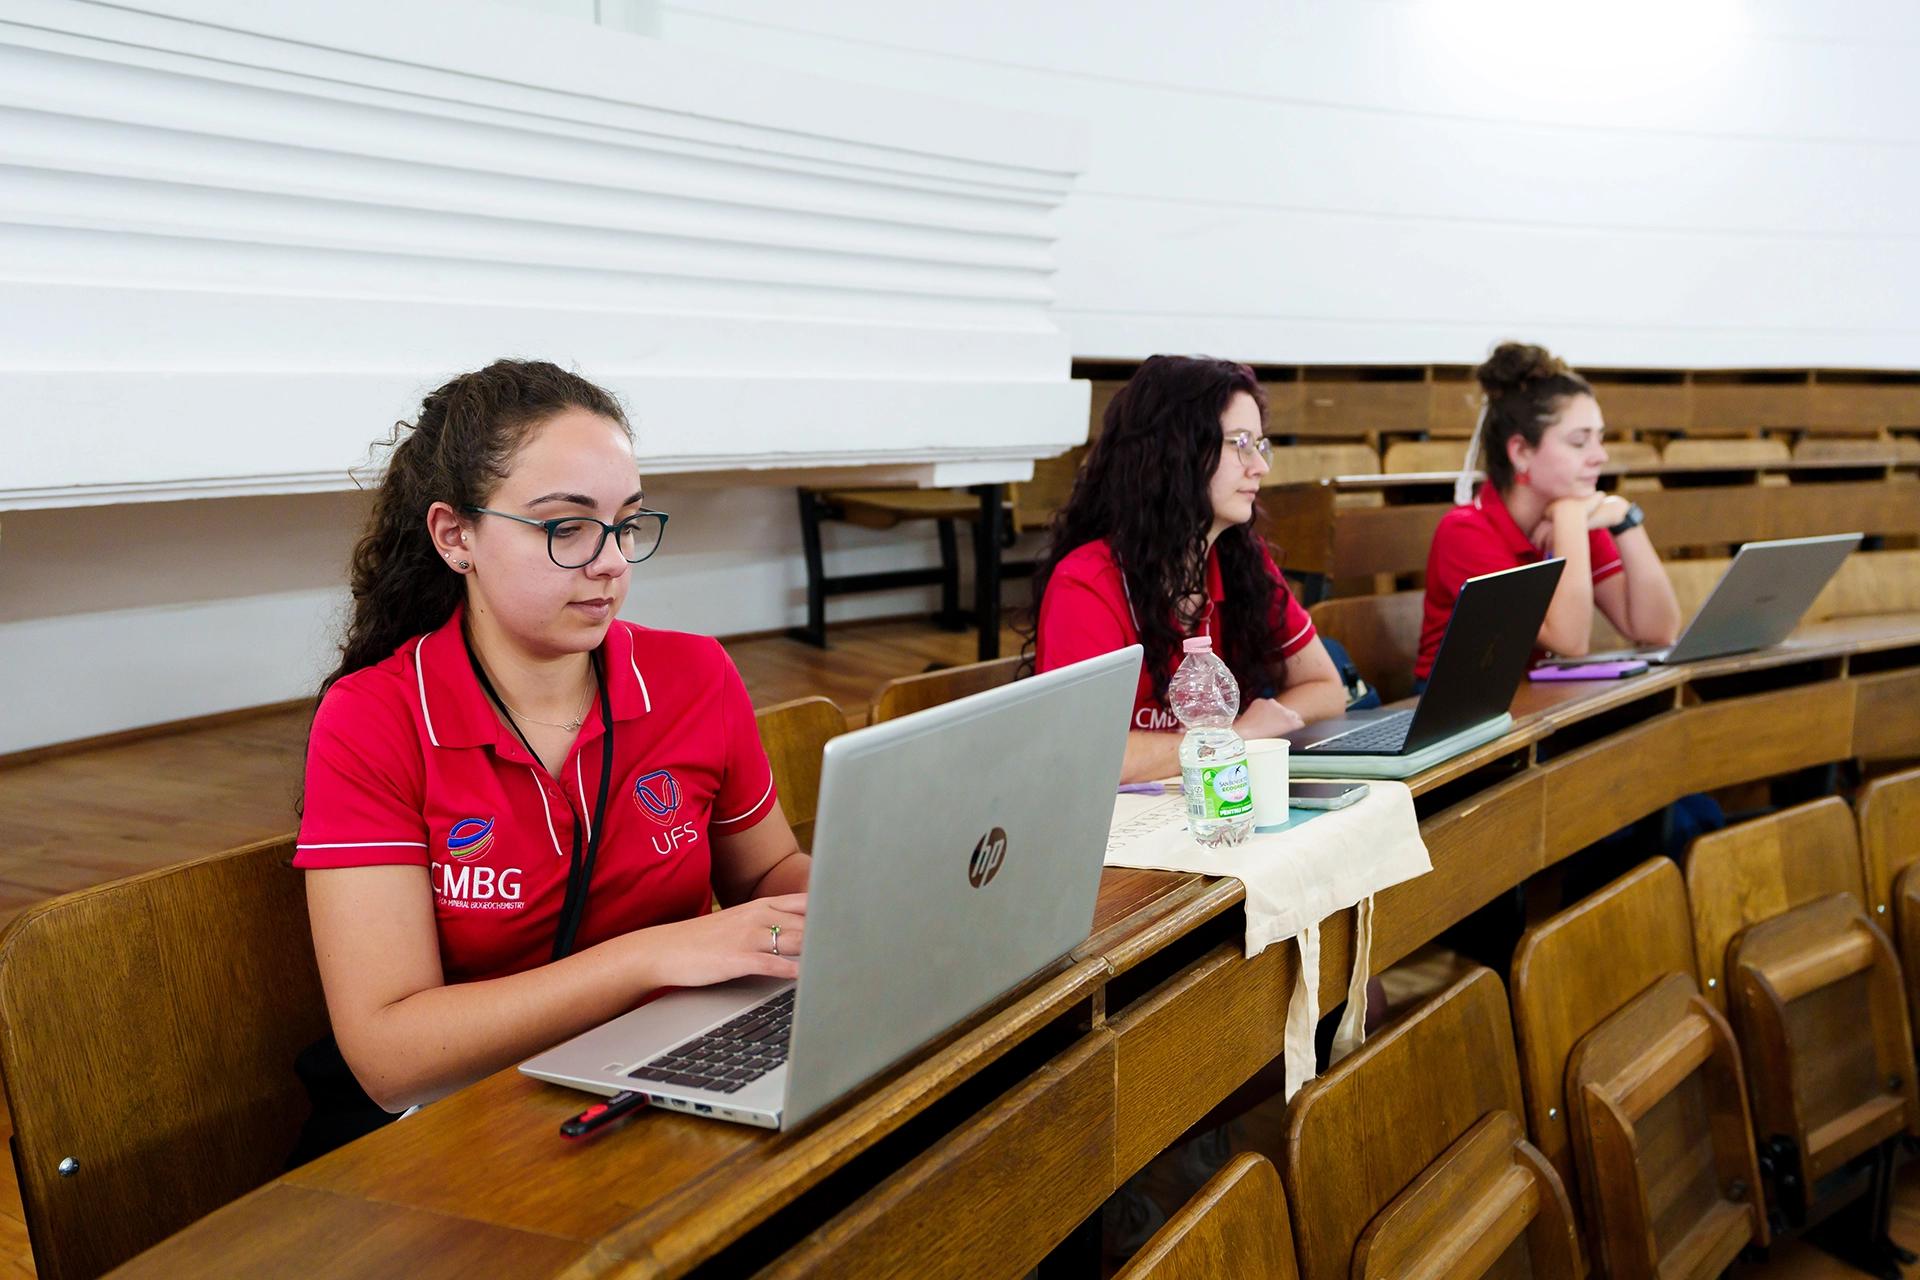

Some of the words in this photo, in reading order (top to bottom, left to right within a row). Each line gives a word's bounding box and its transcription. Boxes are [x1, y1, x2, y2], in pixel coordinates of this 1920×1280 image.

[651, 820, 699, 855] UFS
[970, 830, 1006, 889] hp
[431, 861, 522, 900] CMBG
